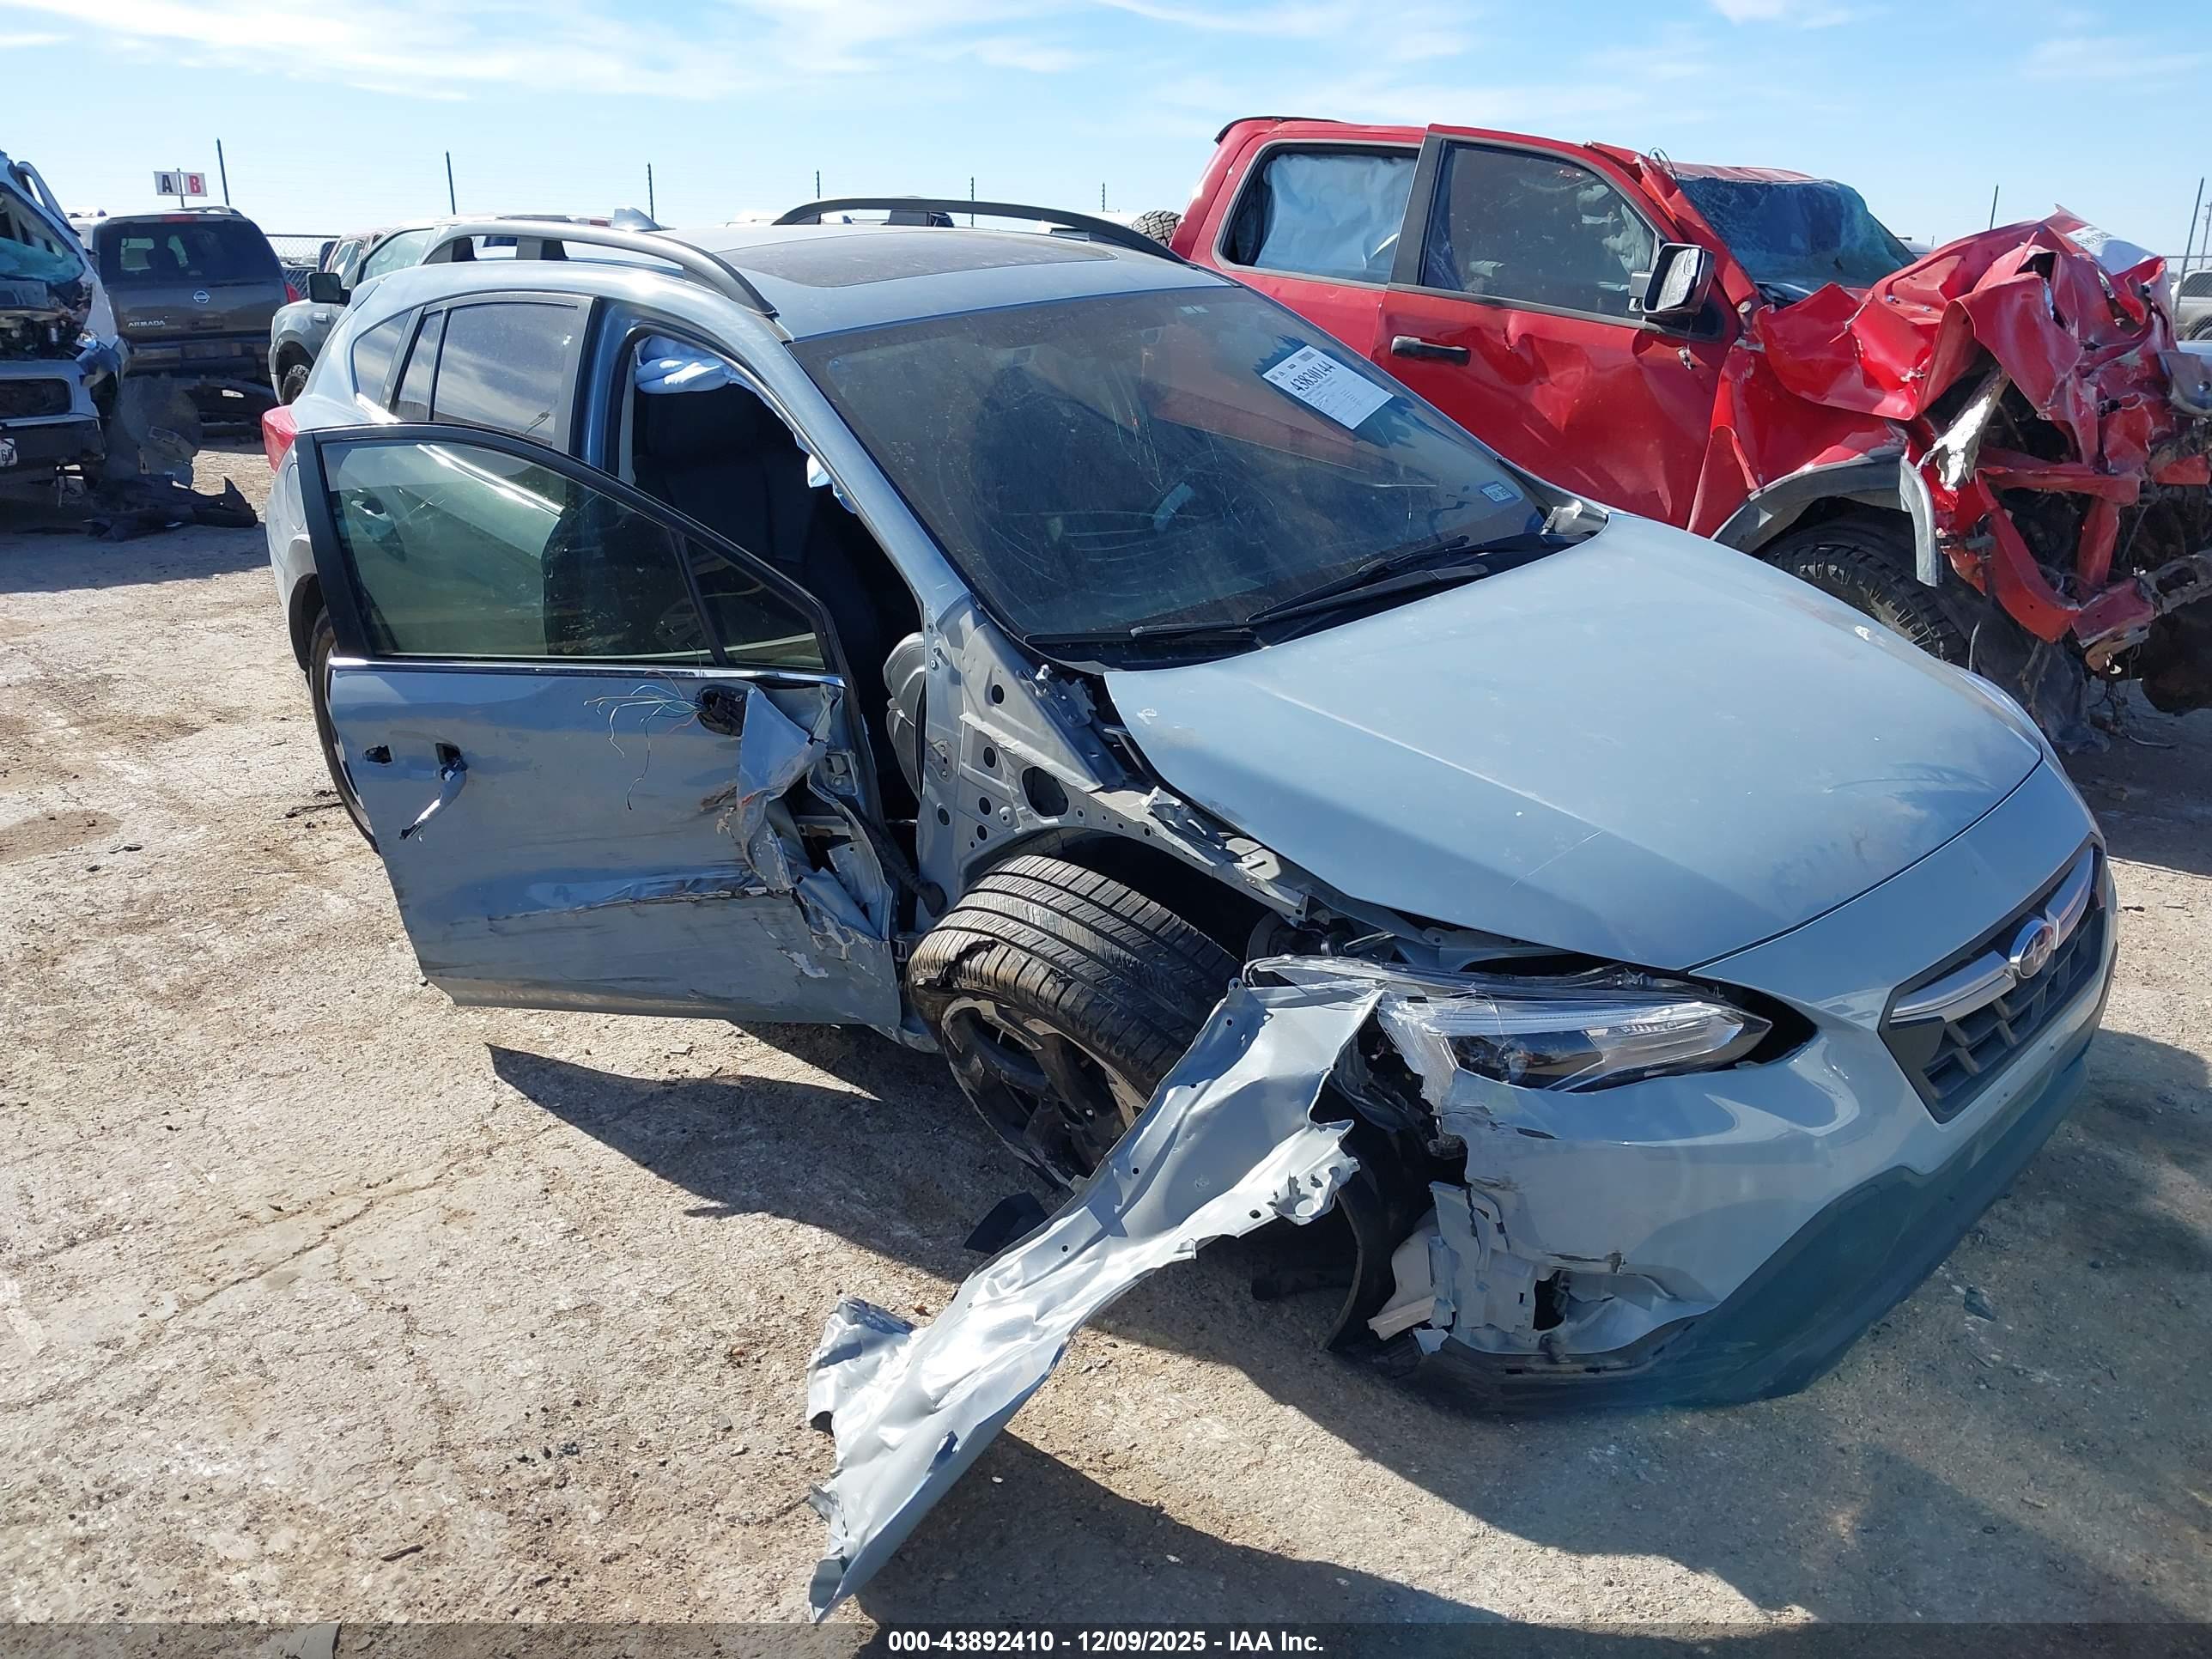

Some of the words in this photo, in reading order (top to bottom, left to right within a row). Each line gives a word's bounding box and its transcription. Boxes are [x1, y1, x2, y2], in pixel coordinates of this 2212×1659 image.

[161, 174, 173, 193] A
[188, 174, 201, 193] B
[127, 319, 166, 329] ARMADA
[1290, 360, 1337, 392] 43830144
